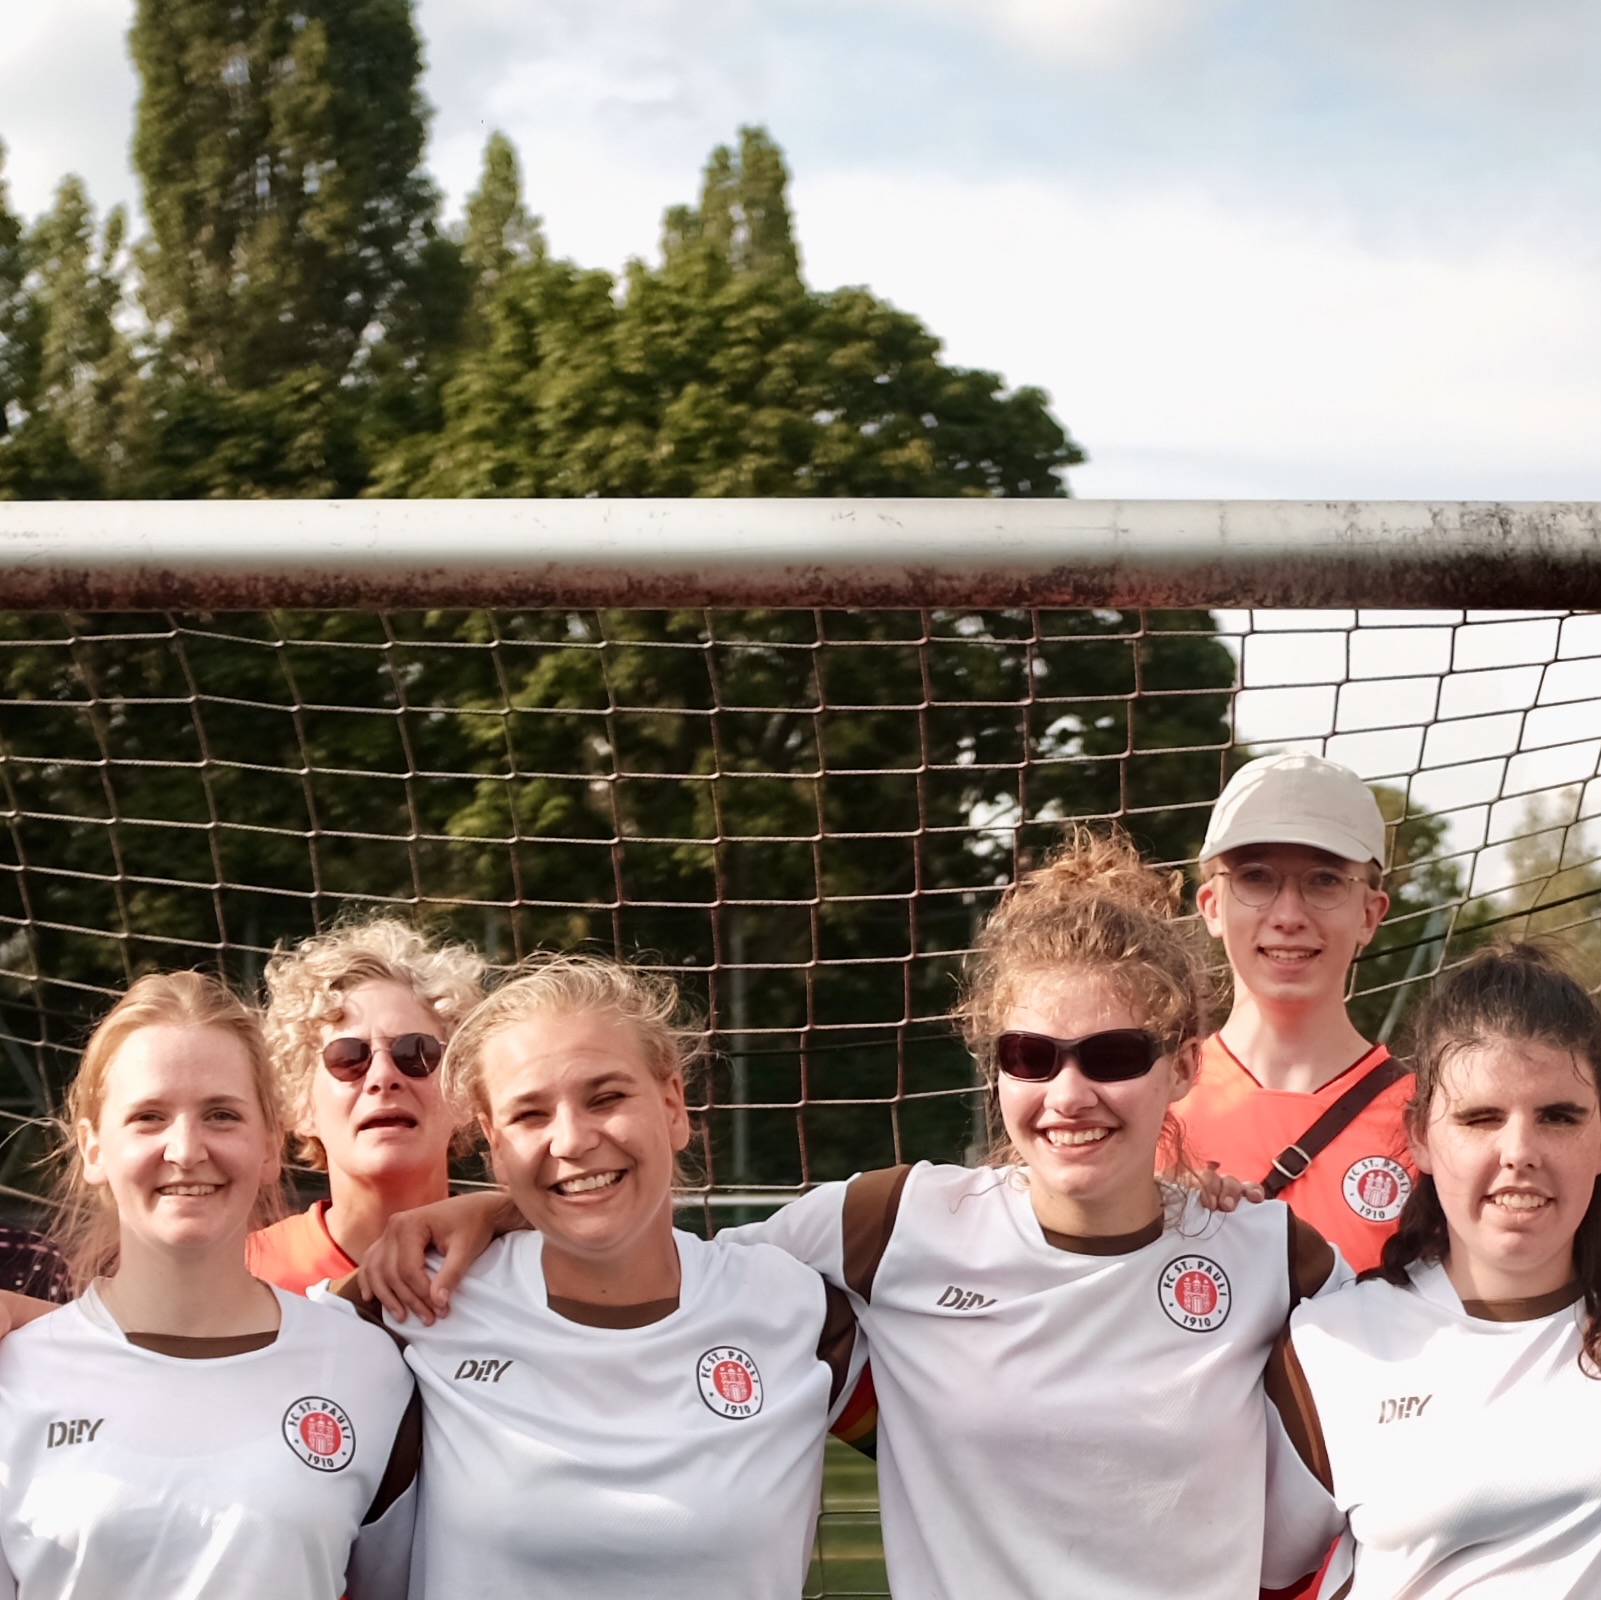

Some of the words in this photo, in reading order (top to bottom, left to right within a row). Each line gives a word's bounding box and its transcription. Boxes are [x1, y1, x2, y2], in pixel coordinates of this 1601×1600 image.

[1348, 1169, 1360, 1182] FC
[1359, 1205, 1386, 1220] 1910
[1163, 1274, 1176, 1289] FC
[1175, 1261, 1193, 1273] ST.
[1197, 1260, 1228, 1297] PAULI
[1182, 1314, 1211, 1328] 1910
[701, 1364, 711, 1379] FC
[728, 1350, 759, 1384] PAULI
[723, 1402, 751, 1415] 1910
[288, 1413, 300, 1427] FC
[321, 1402, 351, 1439] PAULI
[307, 1453, 335, 1468] 1910
